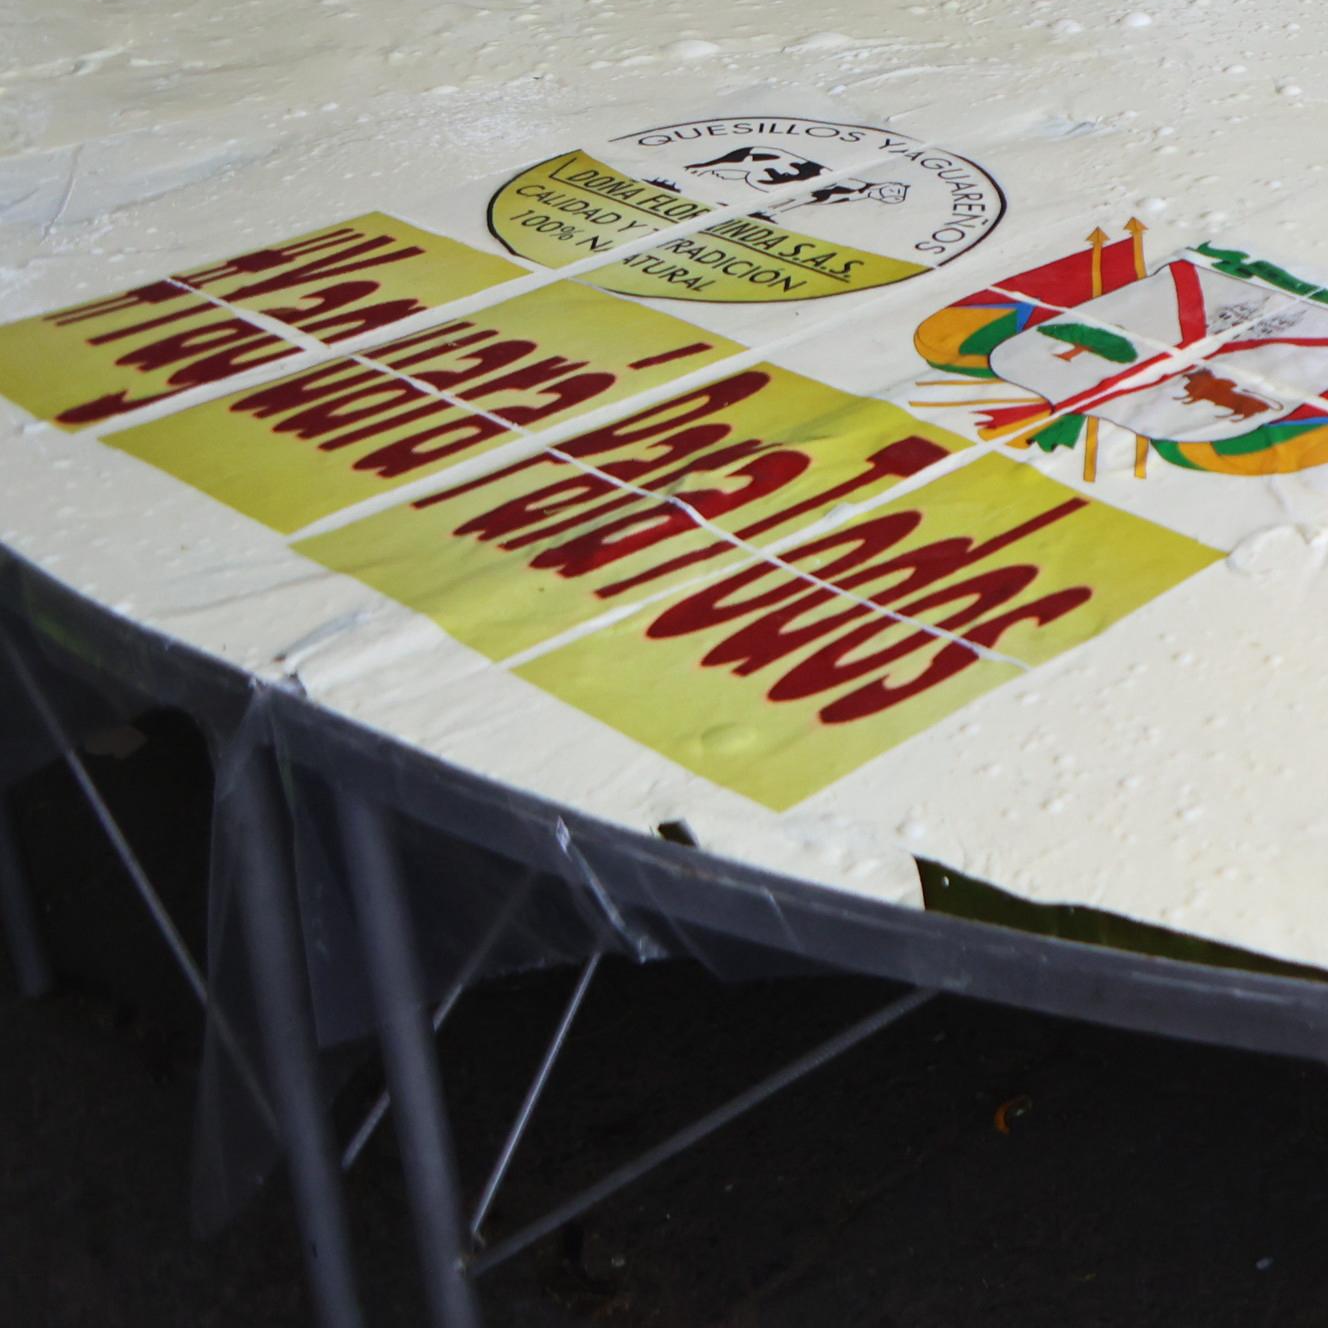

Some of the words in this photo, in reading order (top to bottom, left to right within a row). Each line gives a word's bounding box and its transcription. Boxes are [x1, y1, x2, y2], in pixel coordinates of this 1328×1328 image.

[637, 120, 865, 148] QUESILLOS
[510, 208, 577, 242] 100%
[515, 183, 621, 226] CALIDAD
[617, 221, 649, 233] Y
[779, 242, 865, 279] S.A.S.
[42, 229, 712, 478] #Yaguará
[411, 371, 811, 577] Para
[594, 436, 1093, 725] Todos
